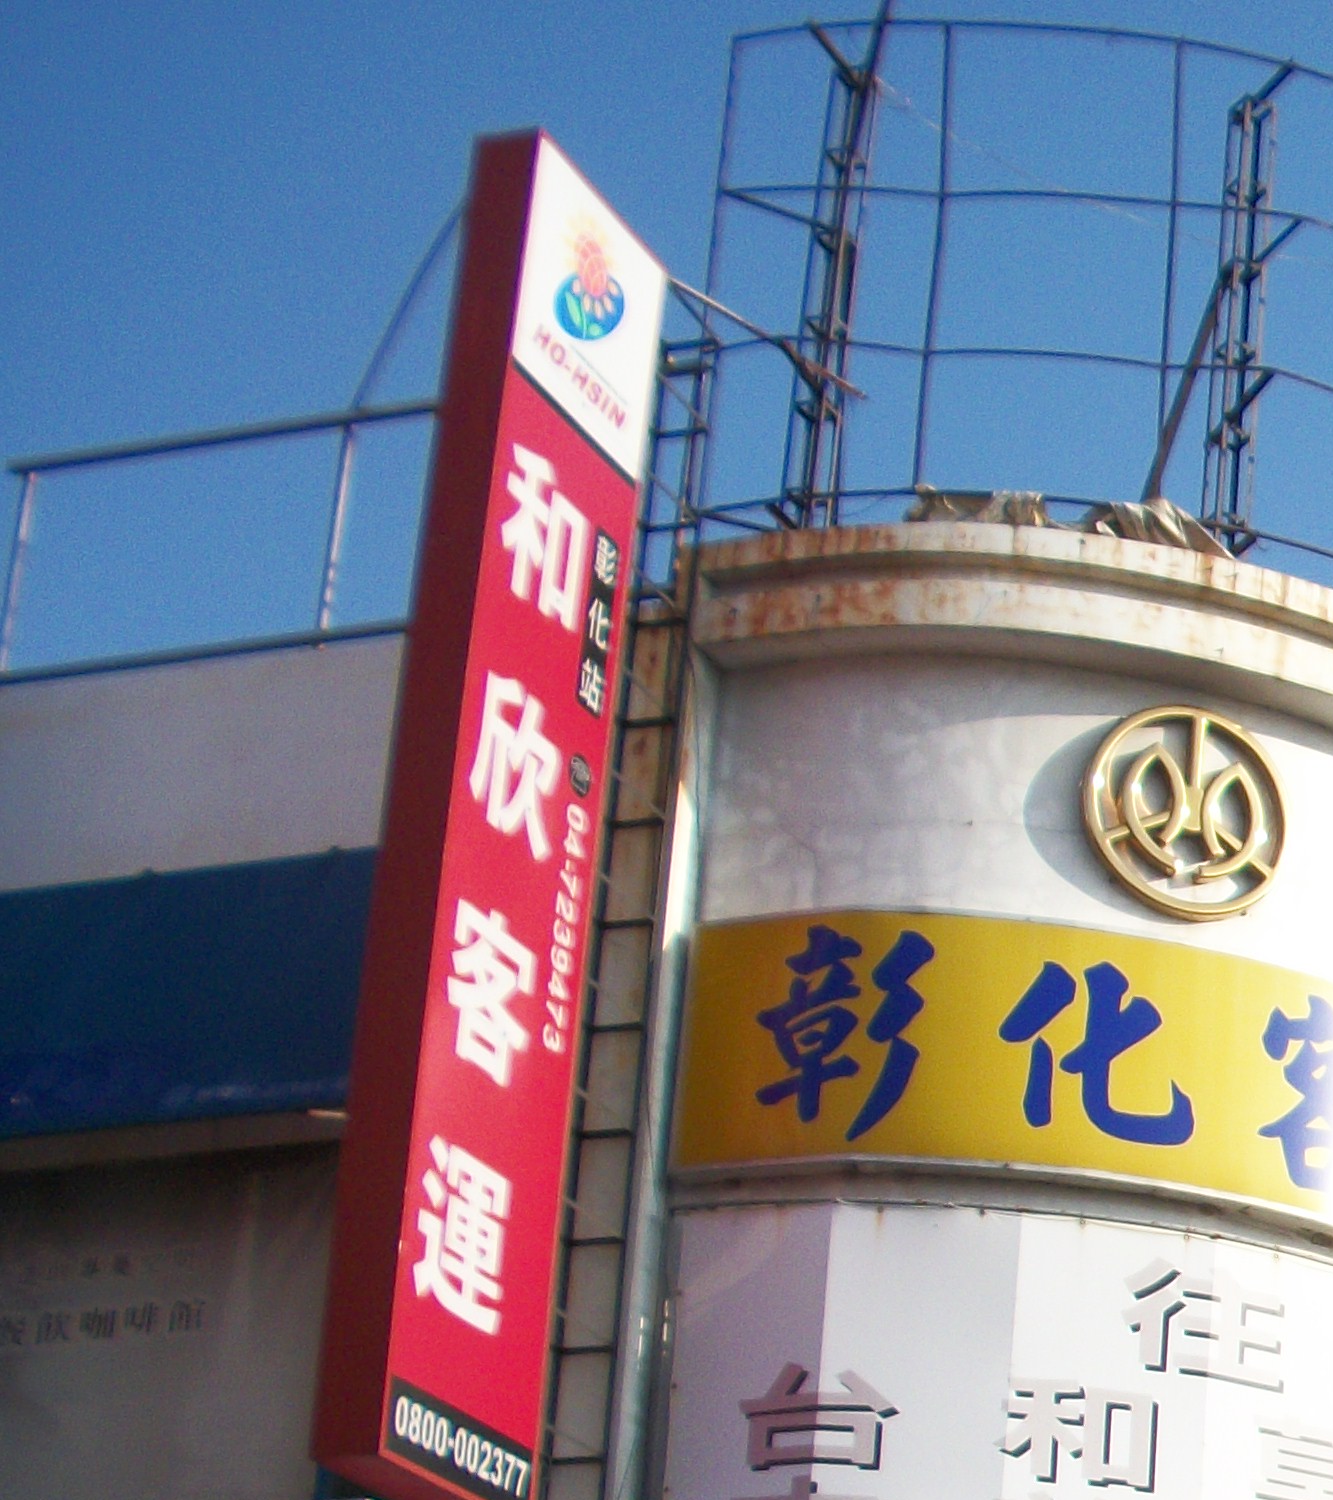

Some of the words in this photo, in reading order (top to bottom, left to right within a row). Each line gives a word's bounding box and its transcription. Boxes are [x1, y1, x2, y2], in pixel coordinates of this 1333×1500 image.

[532, 323, 628, 431] HO-HSIN
[577, 534, 618, 714] 彰化站
[411, 441, 591, 1336] 和欣客運
[542, 803, 591, 1052] 04-7239473
[1122, 1256, 1287, 1394] 往
[394, 1396, 531, 1498] 0800-002377
